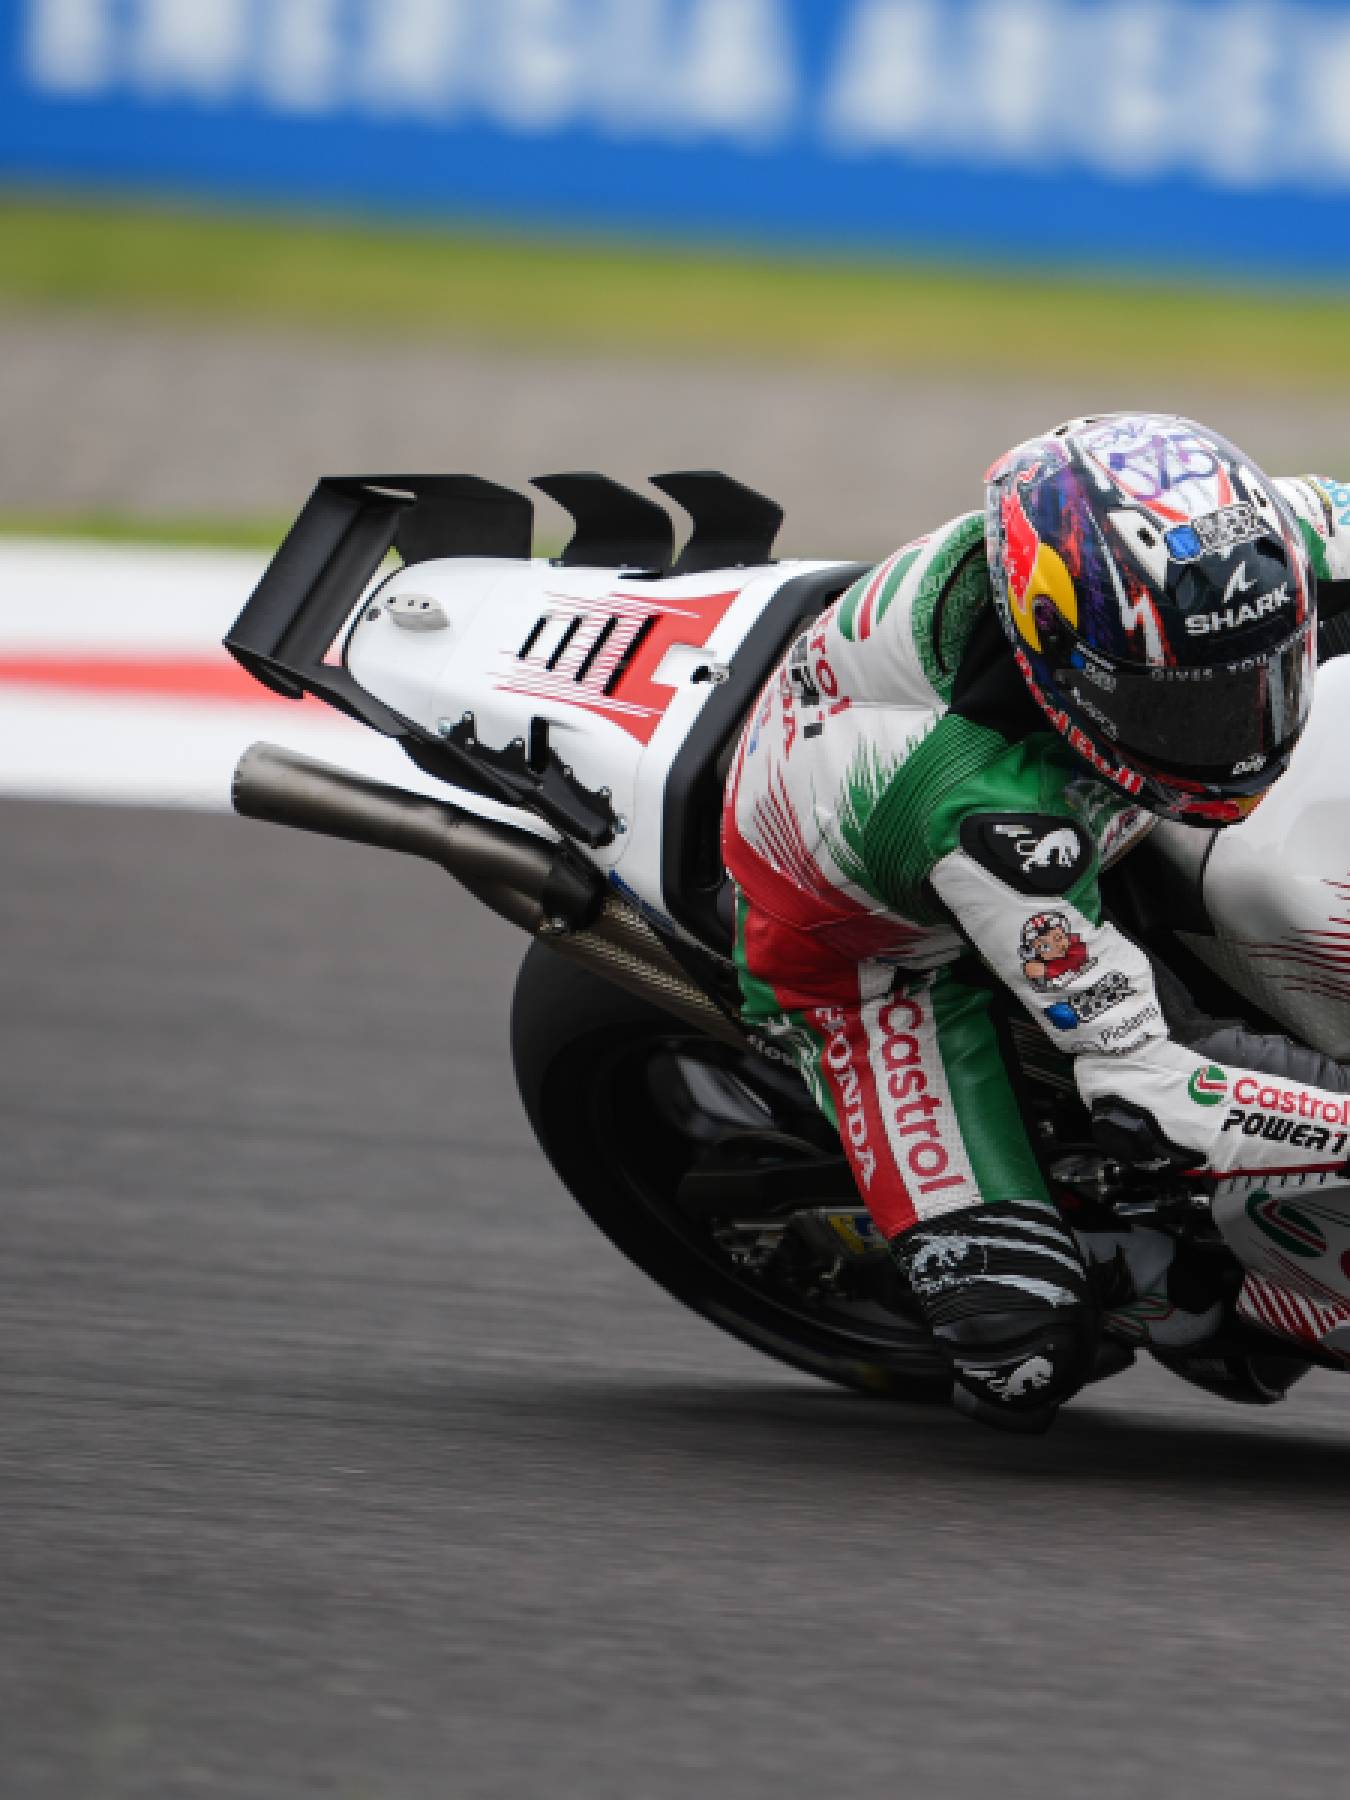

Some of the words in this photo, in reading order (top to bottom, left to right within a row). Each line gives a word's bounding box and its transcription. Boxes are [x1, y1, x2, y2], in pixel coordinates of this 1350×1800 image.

[1184, 582, 1290, 634] SHARK
[812, 1006, 878, 1191] HONDA
[877, 1000, 965, 1195] Castrol
[1232, 1077, 1350, 1126] Castrol
